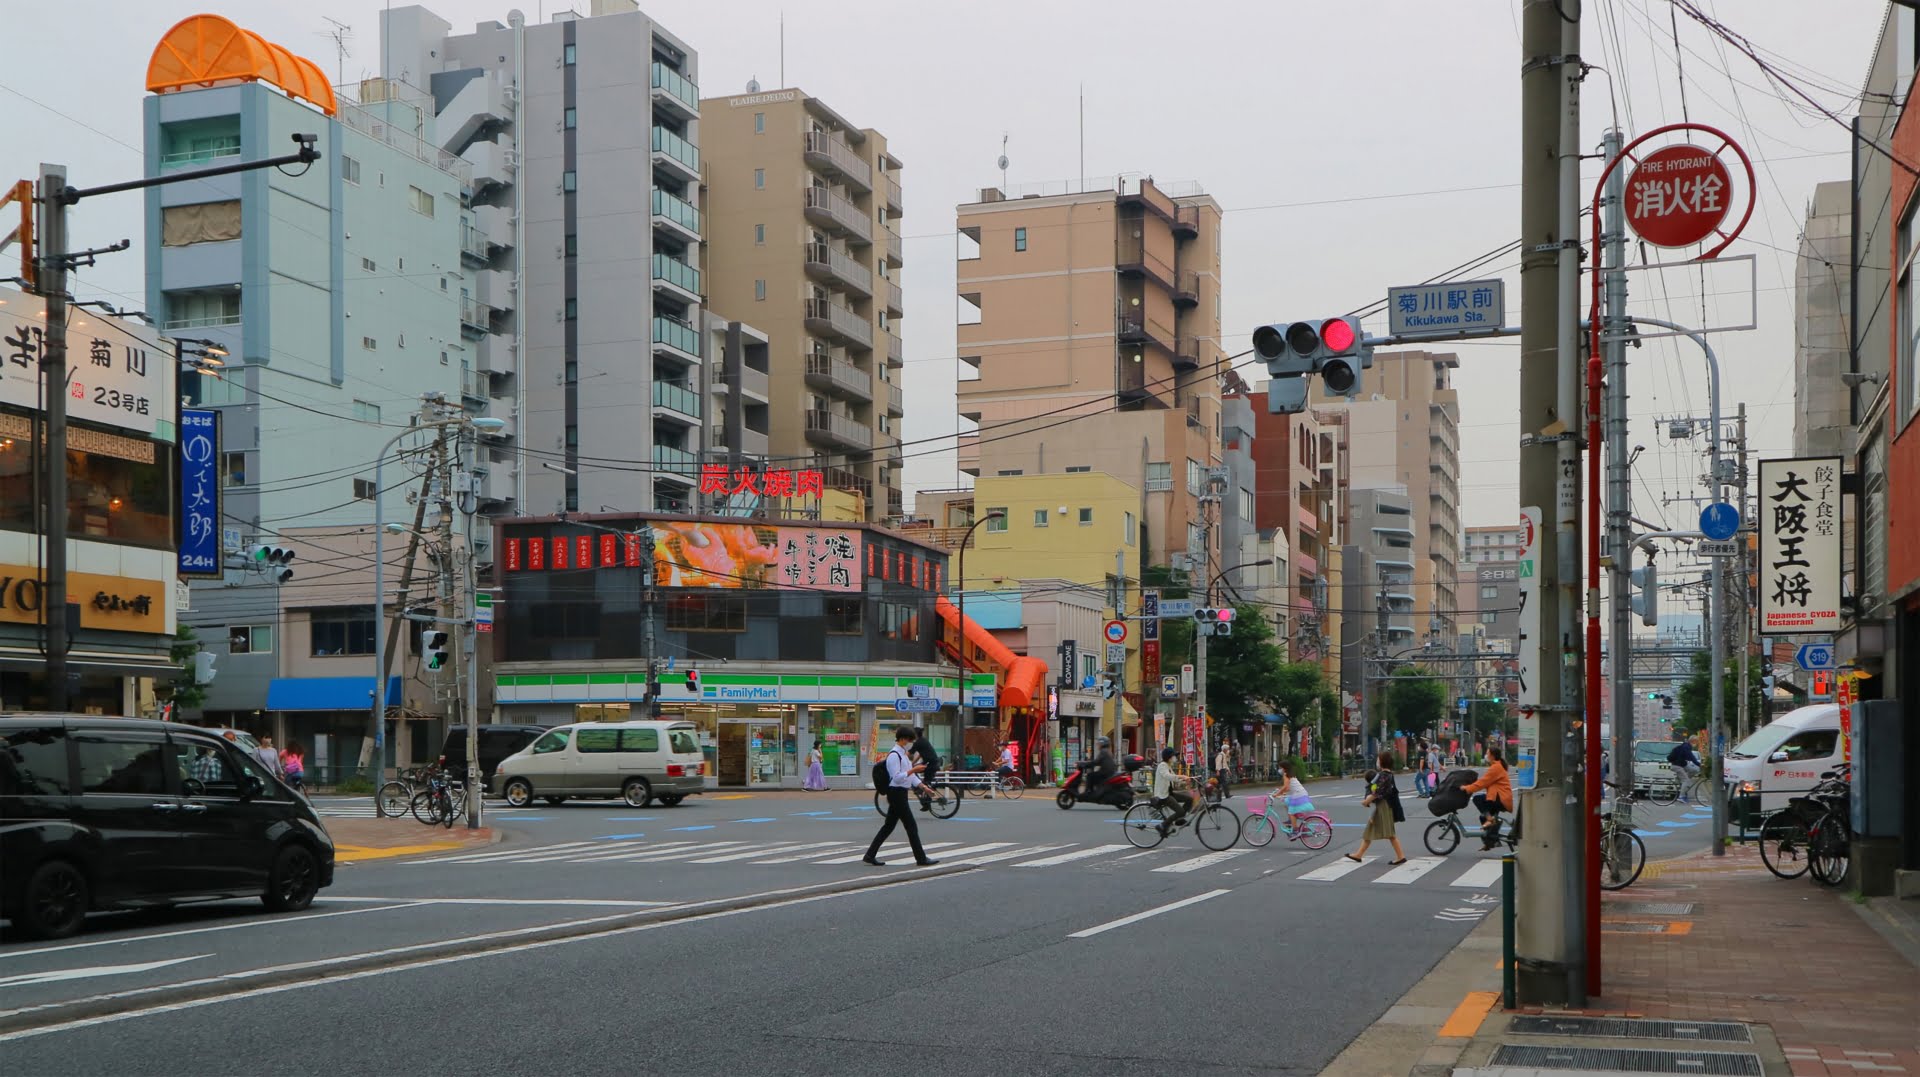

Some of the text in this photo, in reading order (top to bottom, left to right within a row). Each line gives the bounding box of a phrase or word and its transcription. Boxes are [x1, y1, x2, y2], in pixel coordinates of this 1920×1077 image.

[1641, 156, 1712, 173] FIRE HYDRANT
[1633, 173, 1723, 219] 消火栓
[1398, 287, 1493, 314] 菊川駅前
[1405, 311, 1487, 327] Kikukawa Sta.
[90, 337, 146, 377] 菊川
[93, 386, 149, 416] 23号店
[182, 416, 213, 427] おそば
[182, 434, 212, 548] ゆで太郎
[699, 463, 824, 499] 炭火焼肉
[1815, 465, 1834, 537] 餃子食堂
[1700, 544, 1736, 553] 歩行者優先
[1769, 471, 1814, 608] 大阪王将
[182, 554, 214, 567] 24H
[784, 540, 802, 586] 牛坊
[805, 532, 819, 585] ホルモン
[817, 533, 856, 588] 焼肉
[93, 591, 152, 616] やよい軒
[1767, 610, 1837, 622] Japanese GYOZA
[1767, 619, 1815, 627] Restaurant
[1811, 651, 1827, 662] 319
[720, 687, 778, 699] FamilyMart
[1788, 771, 1816, 779] 日本郵便
